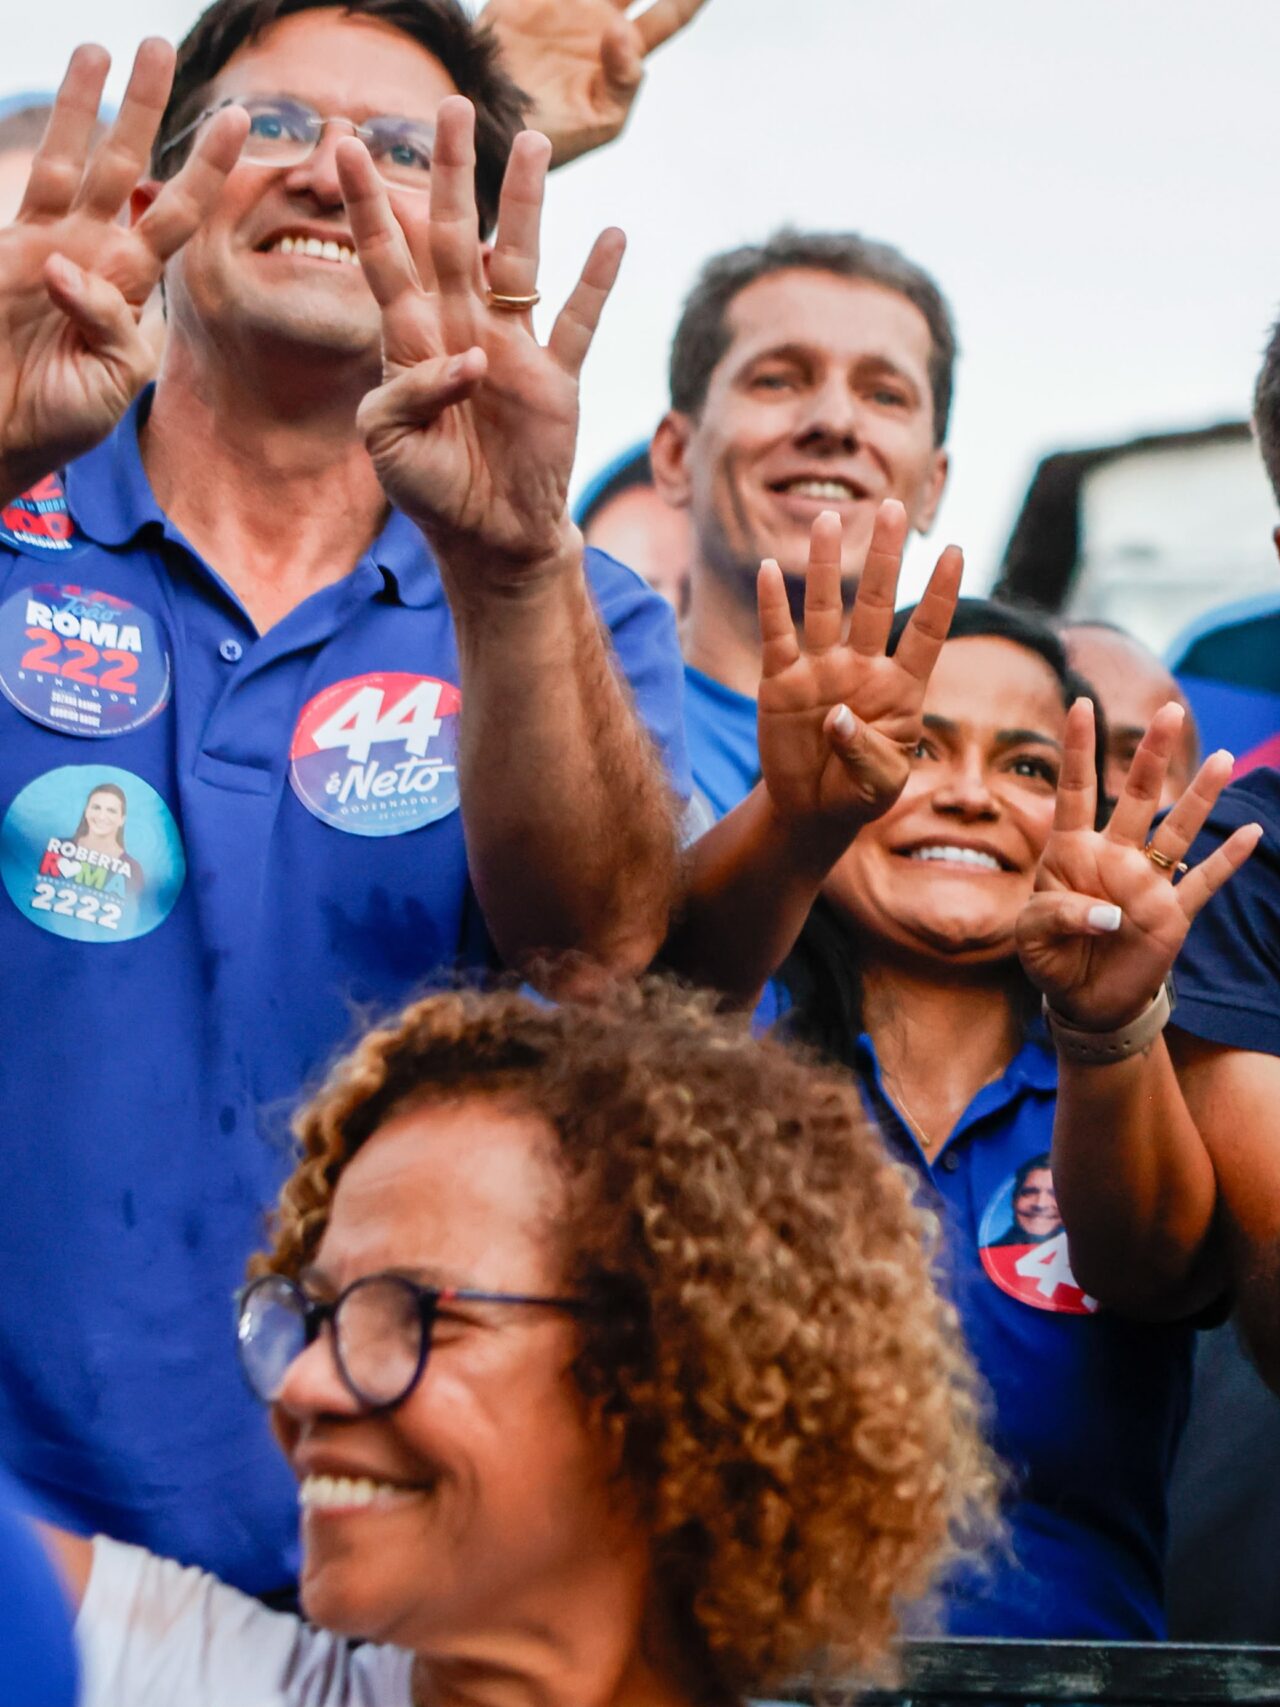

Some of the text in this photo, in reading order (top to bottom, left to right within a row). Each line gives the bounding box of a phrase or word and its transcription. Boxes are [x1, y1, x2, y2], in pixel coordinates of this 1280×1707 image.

[26, 599, 142, 653] ROMA
[21, 627, 139, 695] 222
[312, 681, 443, 764] 44
[337, 756, 456, 804] Neto
[47, 837, 131, 879] ROBERTA
[31, 883, 122, 930] 2222
